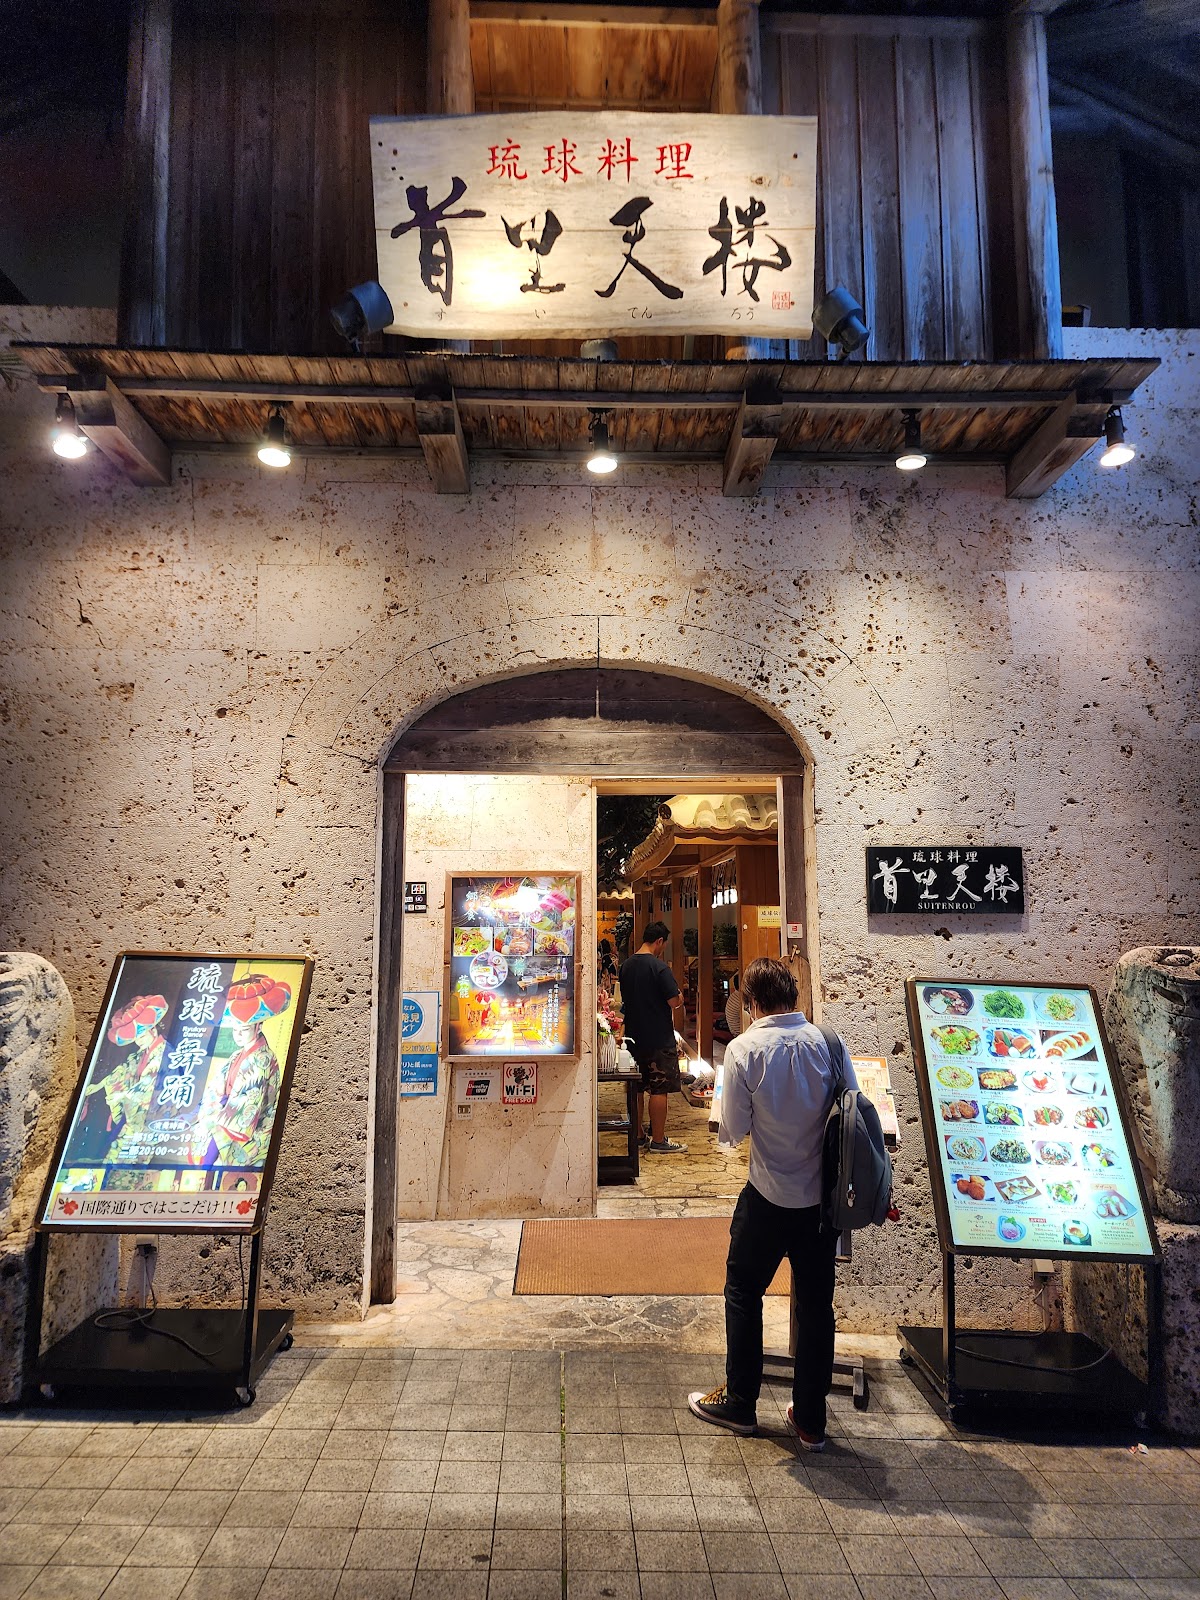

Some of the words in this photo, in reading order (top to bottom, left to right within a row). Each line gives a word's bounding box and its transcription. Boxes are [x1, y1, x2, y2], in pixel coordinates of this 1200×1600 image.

[485, 138, 694, 184] 琉球料理
[391, 176, 792, 306] 首里天楼
[912, 850, 979, 864] 琉球料理
[872, 857, 1020, 904] 首里天楼
[917, 902, 976, 910] SUITENROU
[156, 963, 225, 1109] 琉球舞踊
